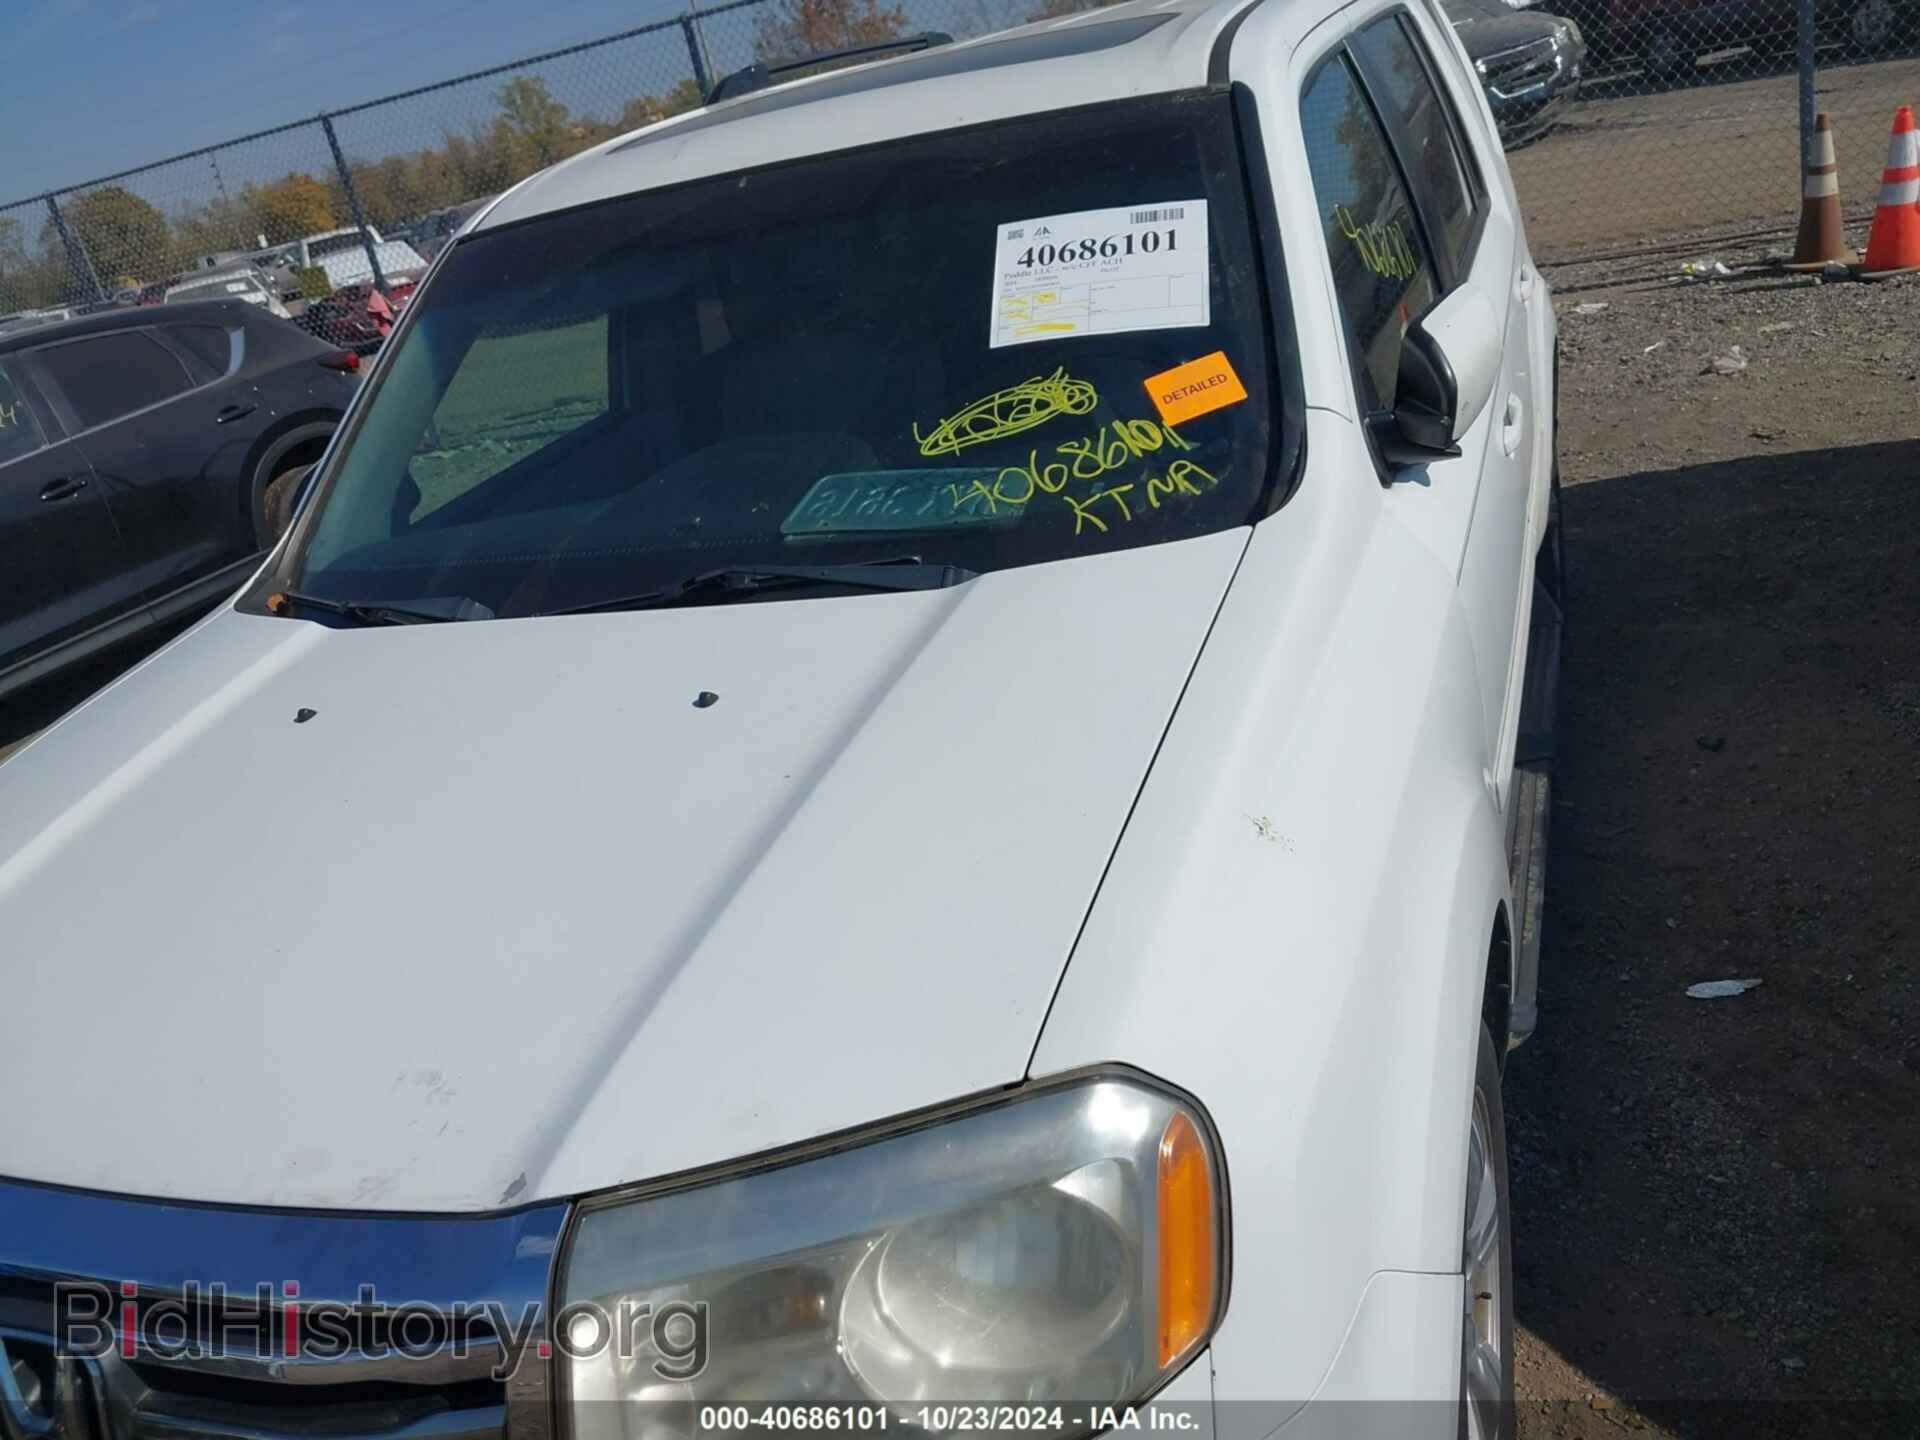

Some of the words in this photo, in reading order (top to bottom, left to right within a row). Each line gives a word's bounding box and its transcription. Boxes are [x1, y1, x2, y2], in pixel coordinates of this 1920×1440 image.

[1017, 228, 1179, 269] 40686101
[1162, 374, 1228, 405] DETAILED
[1063, 483, 1134, 535] KT
